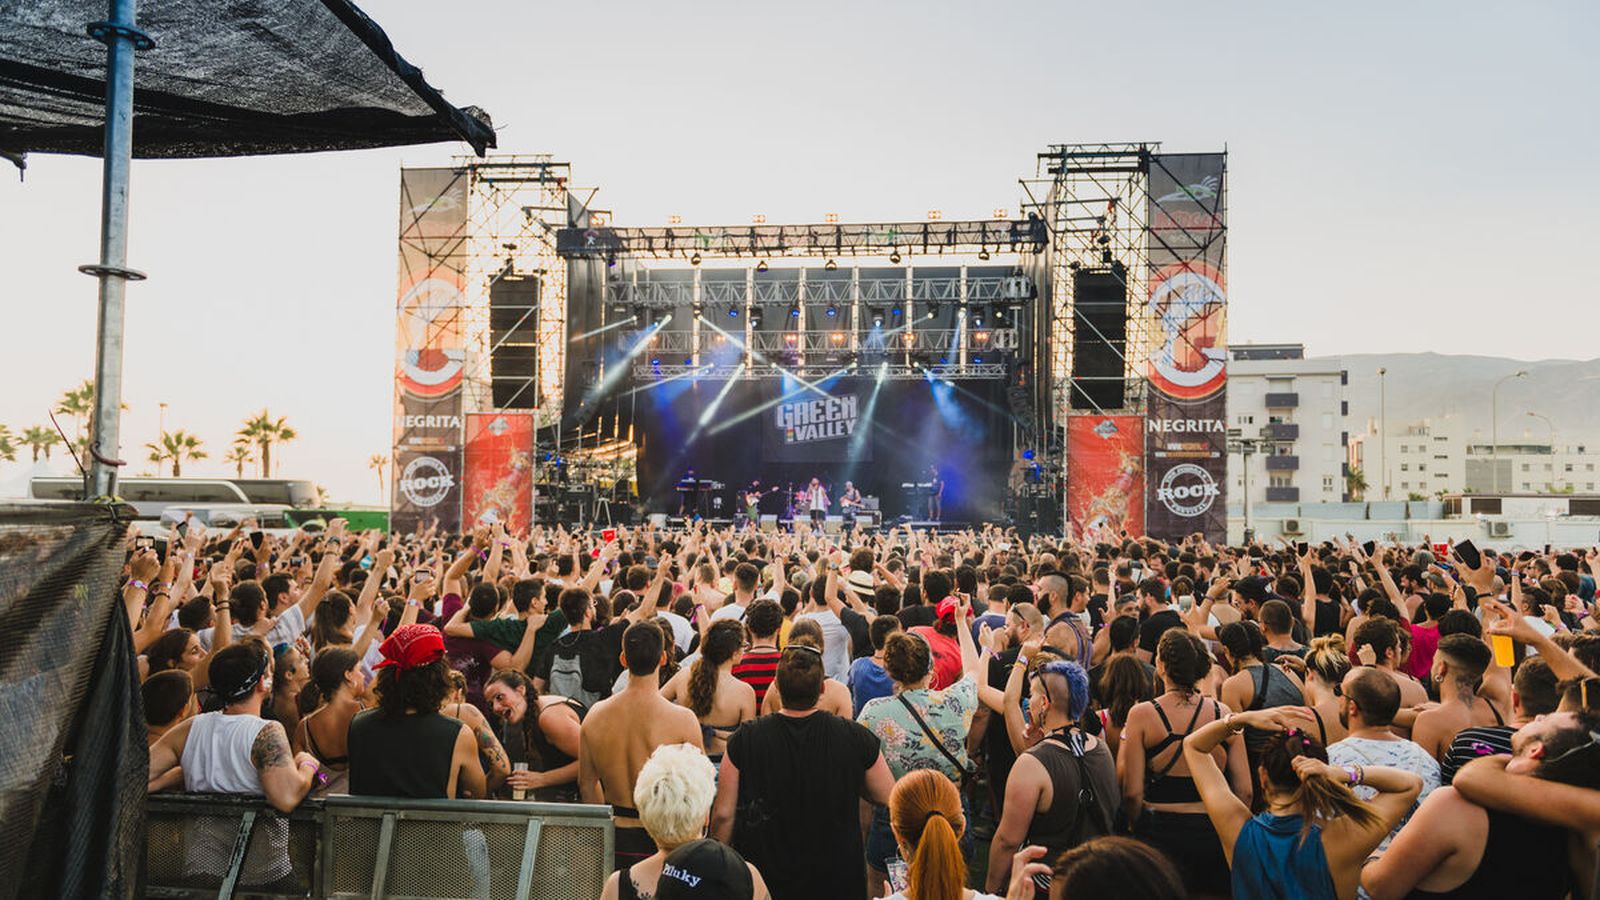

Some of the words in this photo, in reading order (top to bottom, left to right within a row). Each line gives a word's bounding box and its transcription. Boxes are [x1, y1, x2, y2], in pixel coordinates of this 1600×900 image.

[777, 396, 857, 432] GREEN
[795, 419, 856, 441] VALLEY
[1149, 419, 1225, 433] NEGRITA
[400, 475, 455, 491] ROCK
[1157, 483, 1220, 500] ROCK
